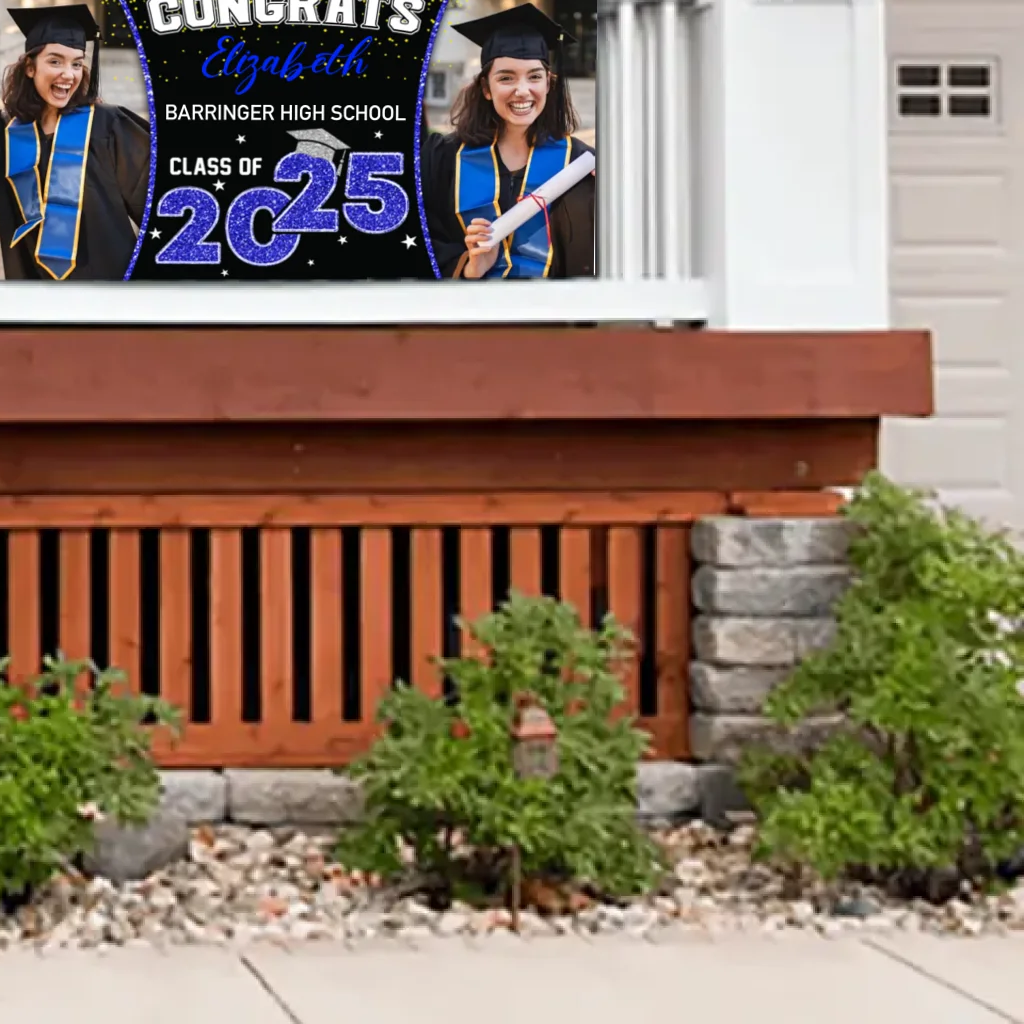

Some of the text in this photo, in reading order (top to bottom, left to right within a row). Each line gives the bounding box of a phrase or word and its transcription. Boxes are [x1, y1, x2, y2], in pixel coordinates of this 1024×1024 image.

[201, 35, 373, 95] Elizabeth
[165, 104, 407, 121] BARRINGER HIGH SCHOOL
[169, 157, 263, 176] CLASS OF
[155, 152, 410, 266] 2025
